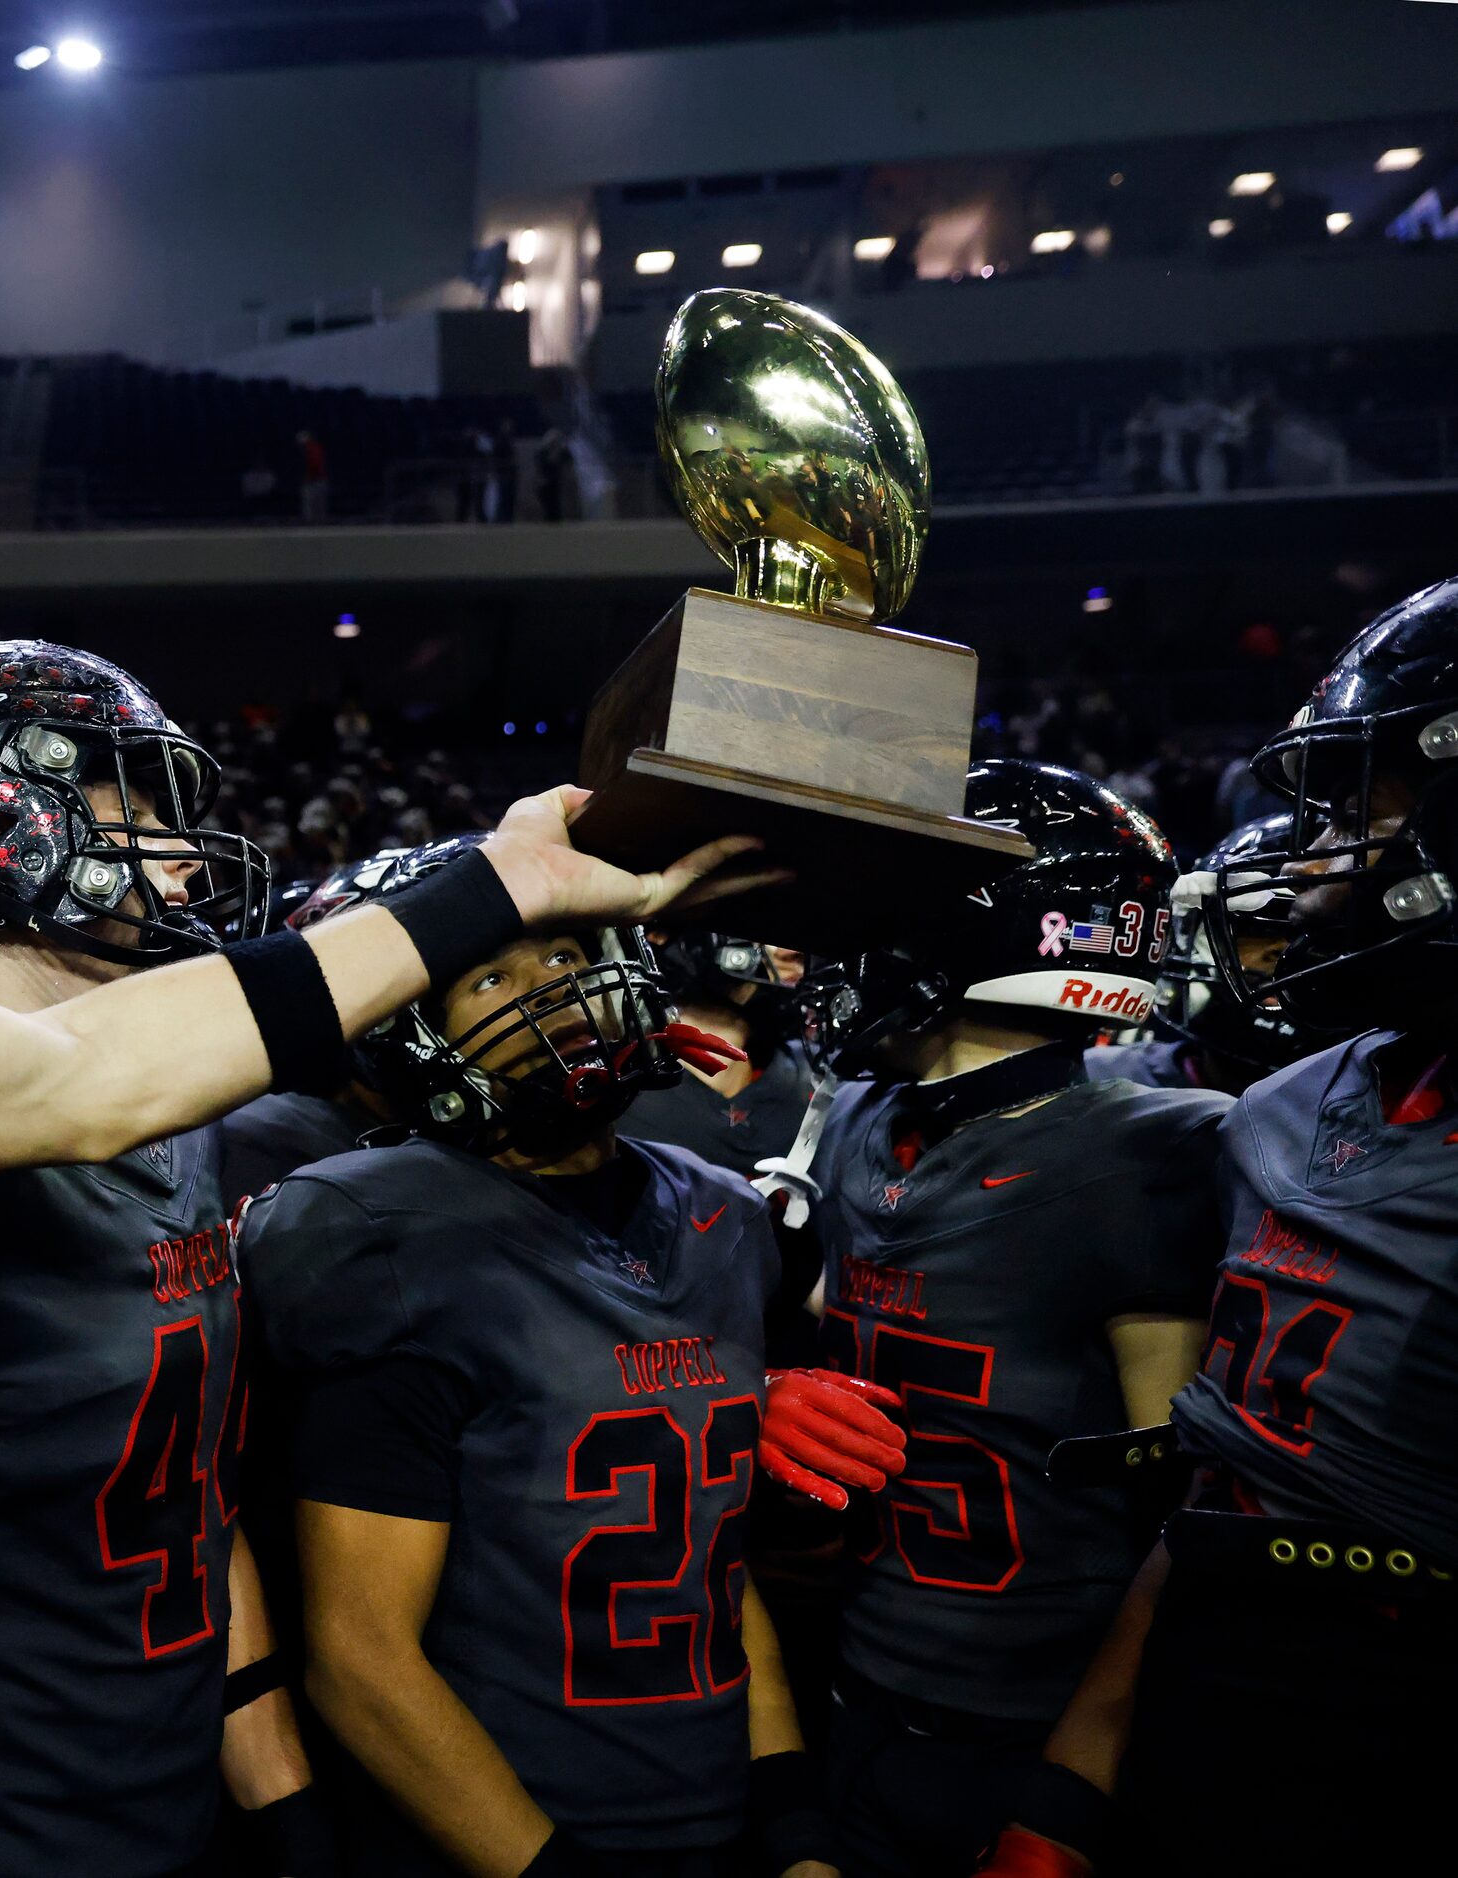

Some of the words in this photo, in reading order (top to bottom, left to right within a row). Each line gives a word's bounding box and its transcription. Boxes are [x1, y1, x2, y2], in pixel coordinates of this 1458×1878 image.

[1114, 900, 1170, 963] 35
[148, 1223, 230, 1304] COPPELL
[613, 1336, 728, 1395] COPPELL
[826, 1306, 1027, 1593] 5
[562, 1393, 763, 1706] 22
